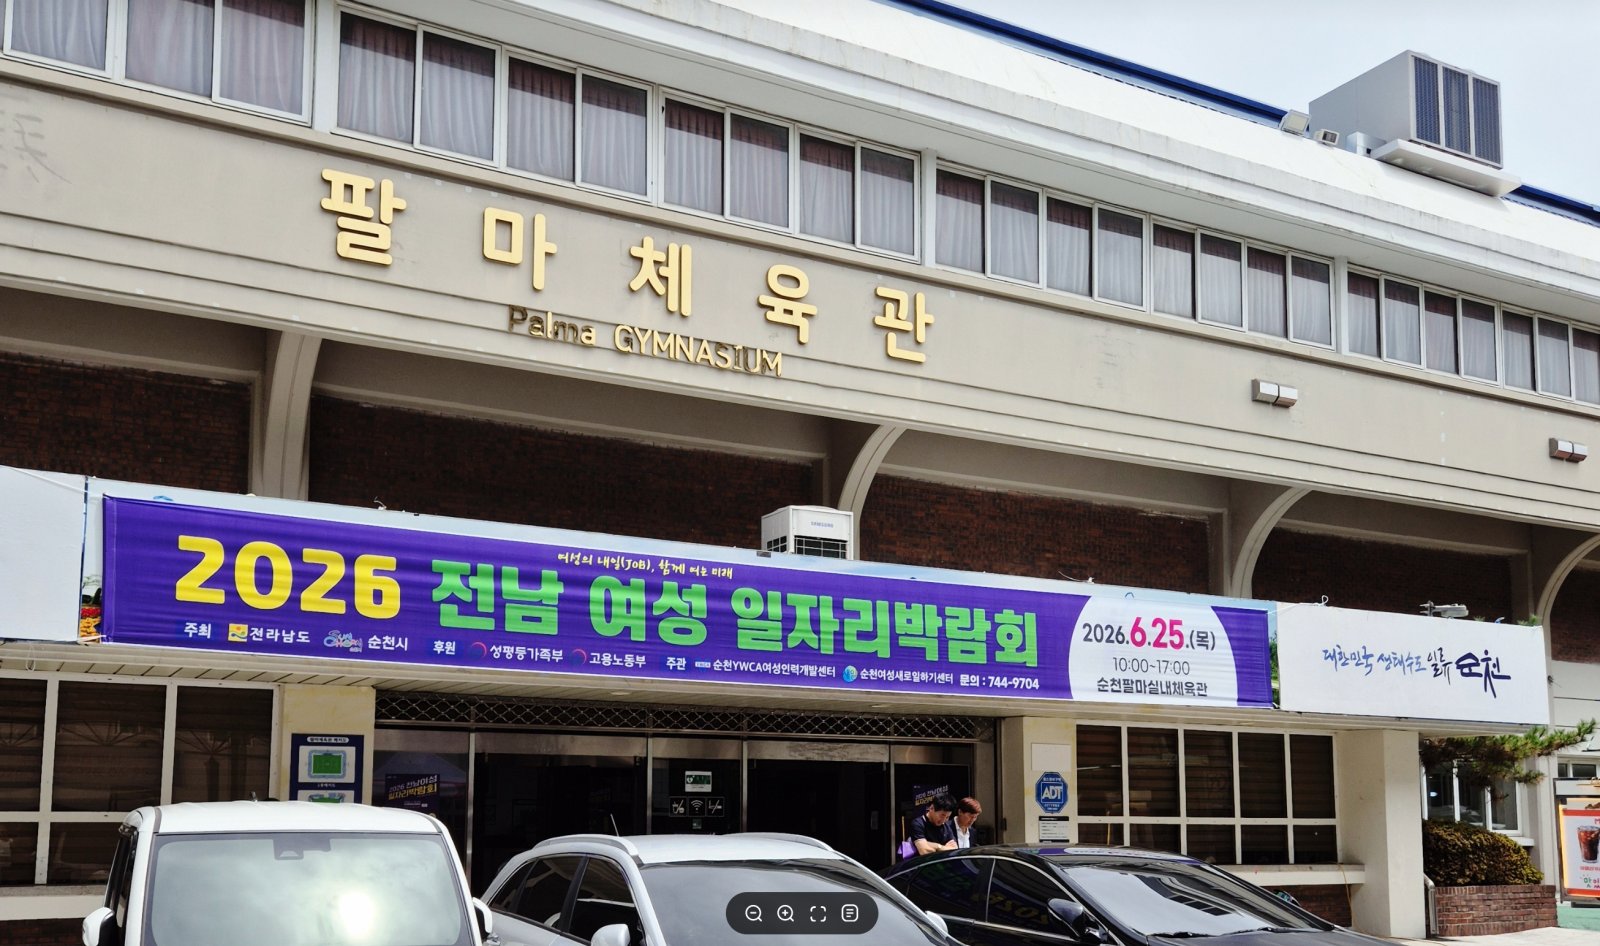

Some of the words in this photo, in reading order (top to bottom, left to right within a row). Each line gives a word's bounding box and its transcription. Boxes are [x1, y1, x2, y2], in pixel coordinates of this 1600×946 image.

[320, 168, 935, 363] 팔마체육관
[508, 303, 597, 346] Palma
[614, 324, 783, 377] GYMNASIUM
[810, 521, 834, 529] SAMSUNG
[557, 552, 593, 566] 여성의
[658, 559, 686, 576] 함께
[689, 565, 708, 577] 여는
[711, 567, 733, 579] 미래
[175, 534, 401, 619] 2026
[431, 559, 565, 636] 전남
[589, 575, 708, 646] 여성
[730, 587, 1038, 667] 일자리박람회
[184, 622, 213, 639] 주최
[249, 626, 311, 643] 전라남도
[367, 635, 409, 651] 순천시
[1082, 616, 1216, 651] 2026.6.25.(목)
[433, 640, 456, 655] 후원
[489, 645, 564, 662] 성평등가족부
[589, 652, 647, 668] 고용노동부
[666, 656, 687, 671] 주관
[712, 659, 837, 679] 순천YWCA여성인력개발센터
[859, 668, 955, 684] 순천여성새로일하기센터
[959, 674, 980, 688] 문의
[988, 676, 1040, 690] 744-9704
[1112, 657, 1191, 676] 10:00~17:00
[1322, 644, 1375, 676] 대한민국
[1377, 652, 1427, 676] 생태수도
[1427, 647, 1453, 685] 일류
[1455, 649, 1512, 699] 순천
[1096, 677, 1208, 697] 순천팔마실내체육관
[1041, 785, 1063, 800] ADT
